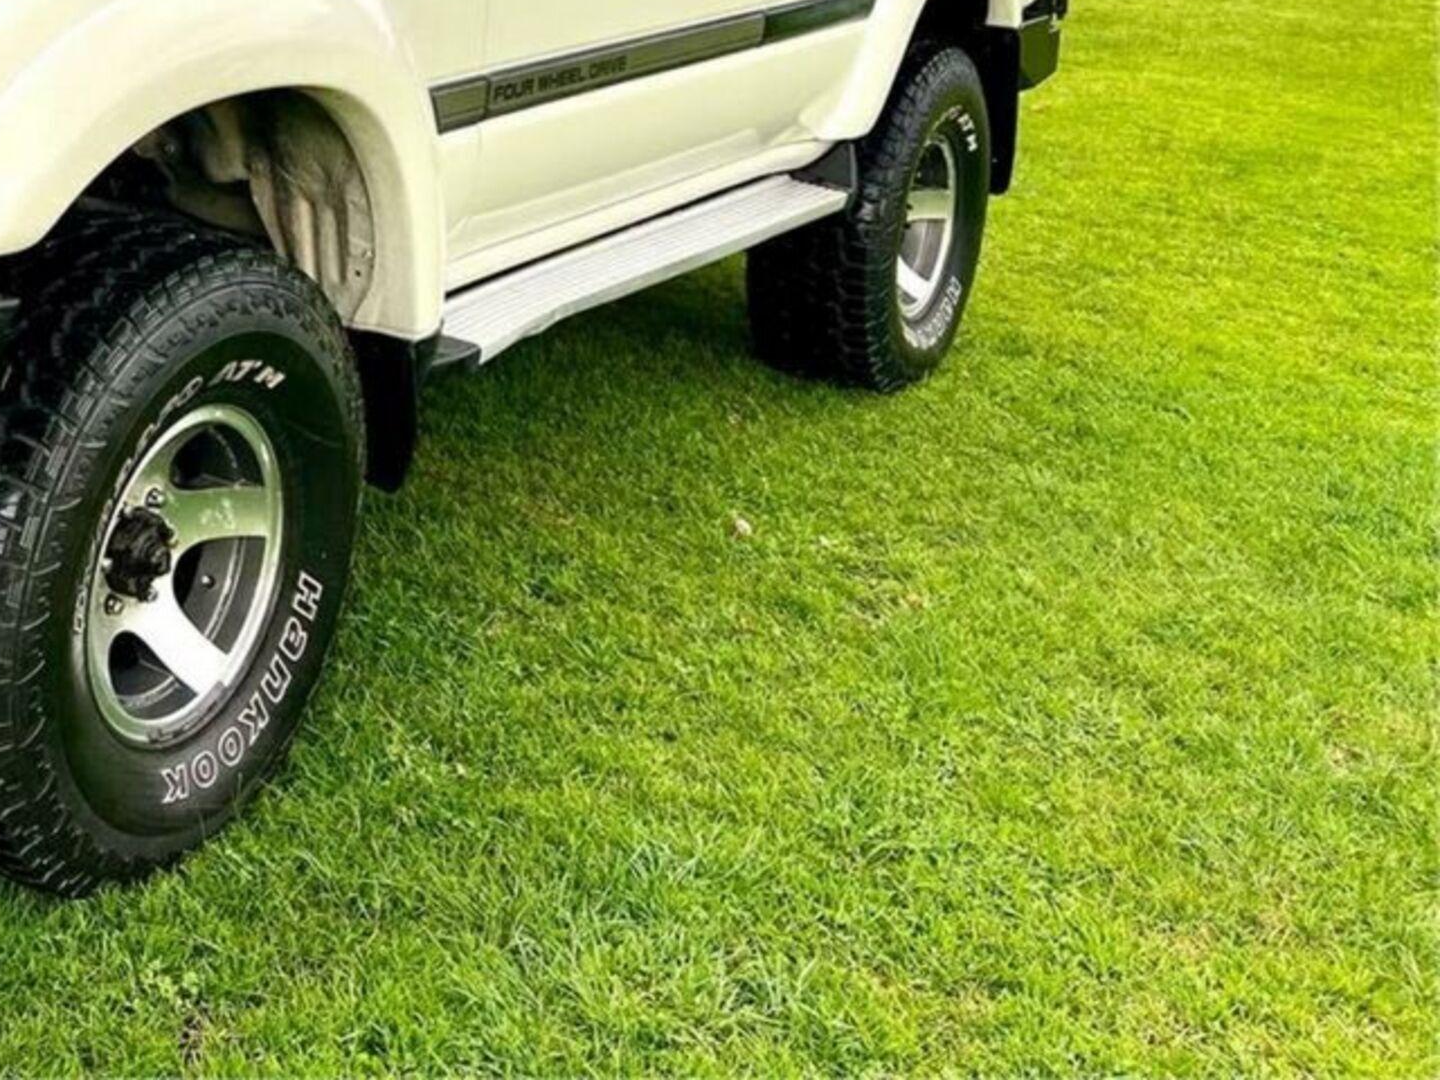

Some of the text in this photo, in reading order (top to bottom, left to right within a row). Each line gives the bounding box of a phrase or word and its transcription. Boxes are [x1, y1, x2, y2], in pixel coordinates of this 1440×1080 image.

[494, 55, 627, 101] FOUR WHEEL DRIVE
